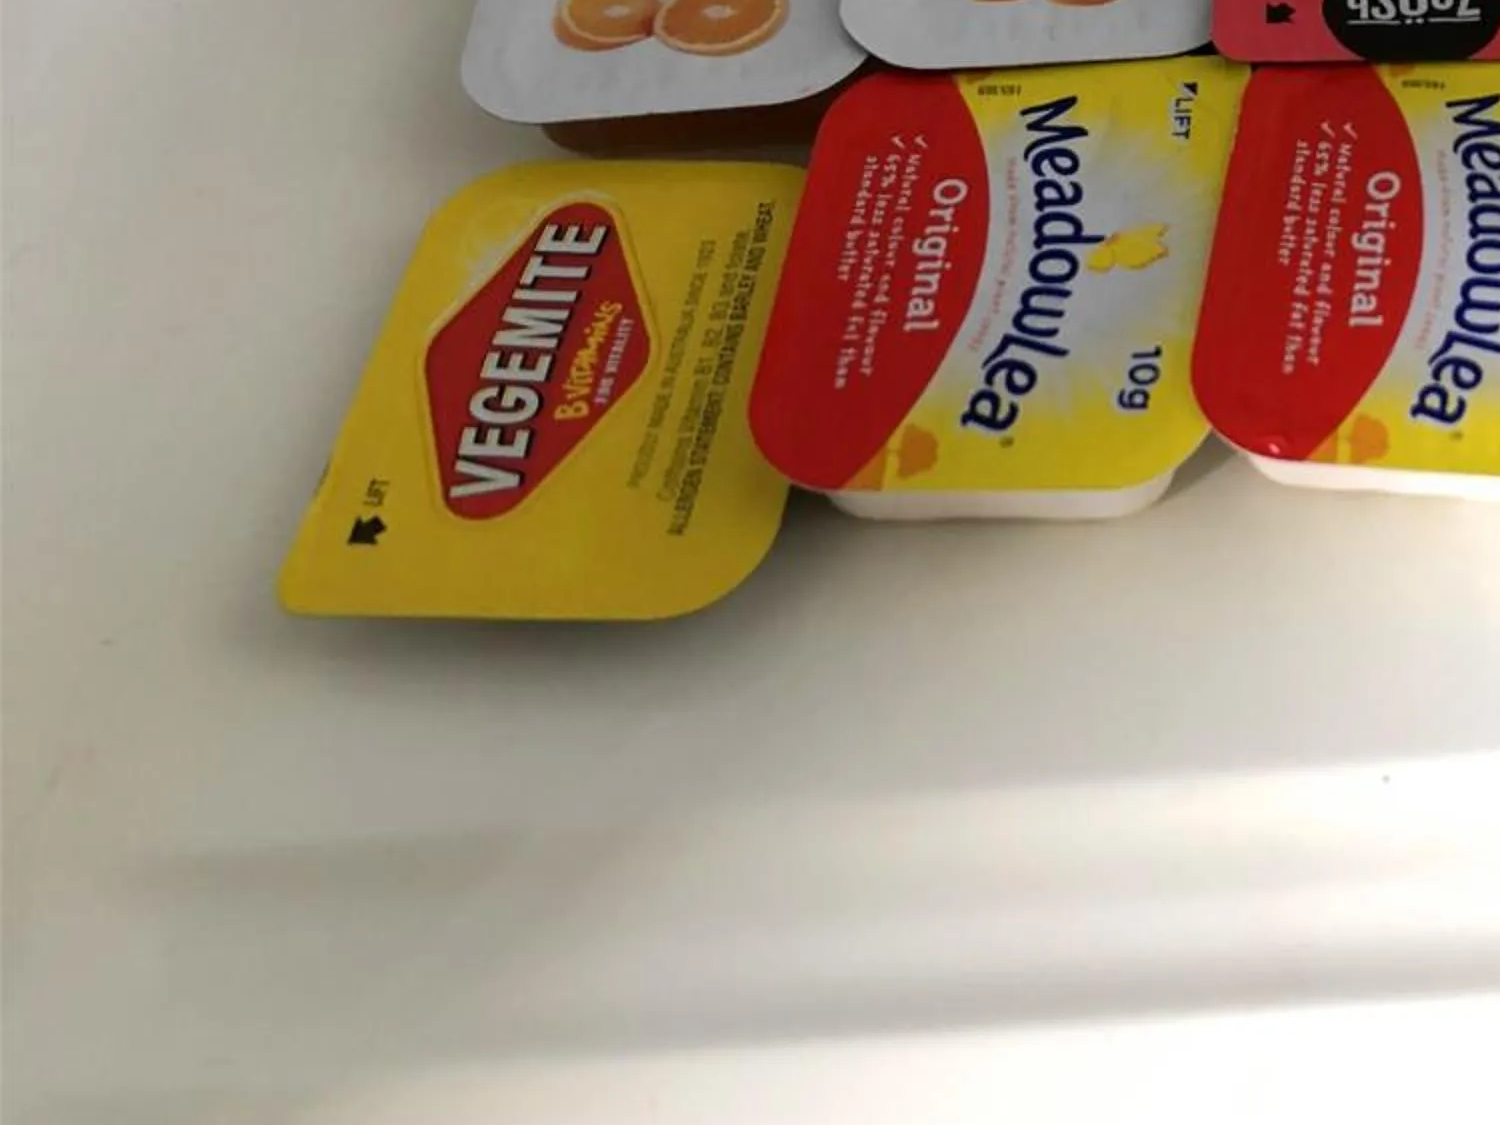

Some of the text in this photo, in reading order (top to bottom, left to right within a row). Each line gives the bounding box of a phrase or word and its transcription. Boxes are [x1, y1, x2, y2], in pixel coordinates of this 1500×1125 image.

[1173, 96, 1194, 141] LIFT
[903, 178, 969, 334] Original
[1347, 169, 1401, 329] Original
[449, 223, 610, 499] VEGEMITE
[554, 393, 591, 421] B
[1116, 345, 1163, 413] 10g
